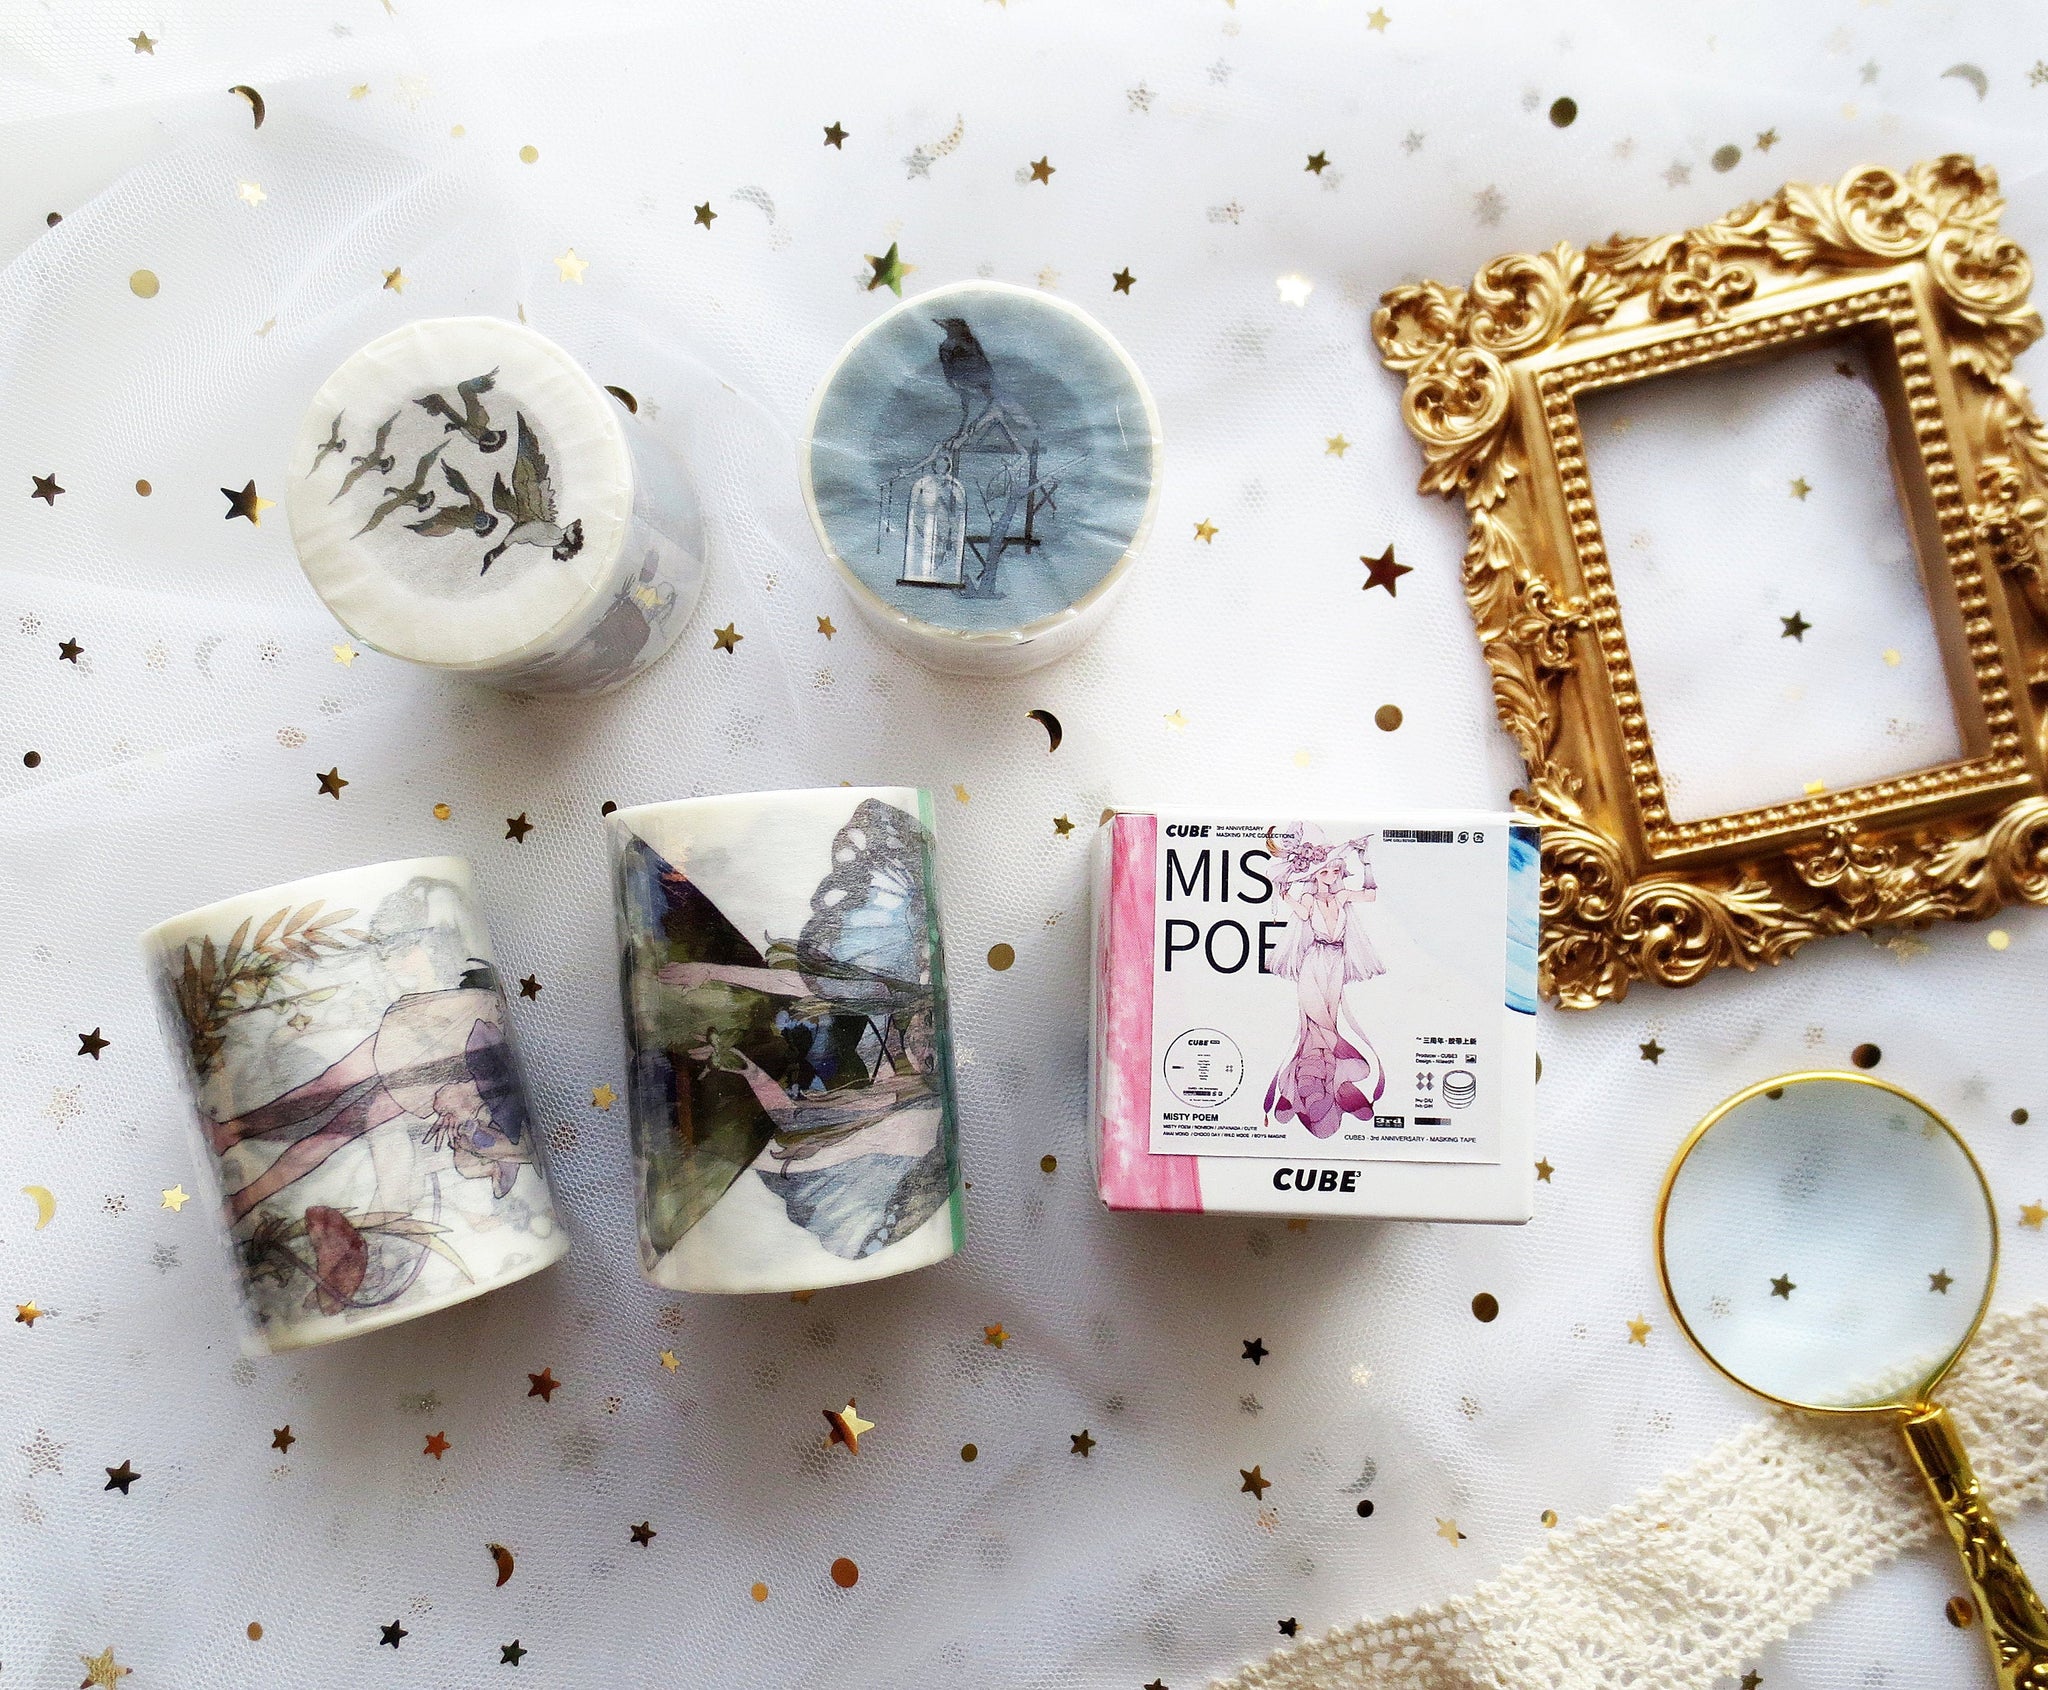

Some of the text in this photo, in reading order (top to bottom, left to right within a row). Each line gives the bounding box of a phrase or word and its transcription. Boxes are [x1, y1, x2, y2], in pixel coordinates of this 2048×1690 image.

[1165, 849, 1273, 904] MIS
[1163, 1112, 1219, 1122] MISTY POEM
